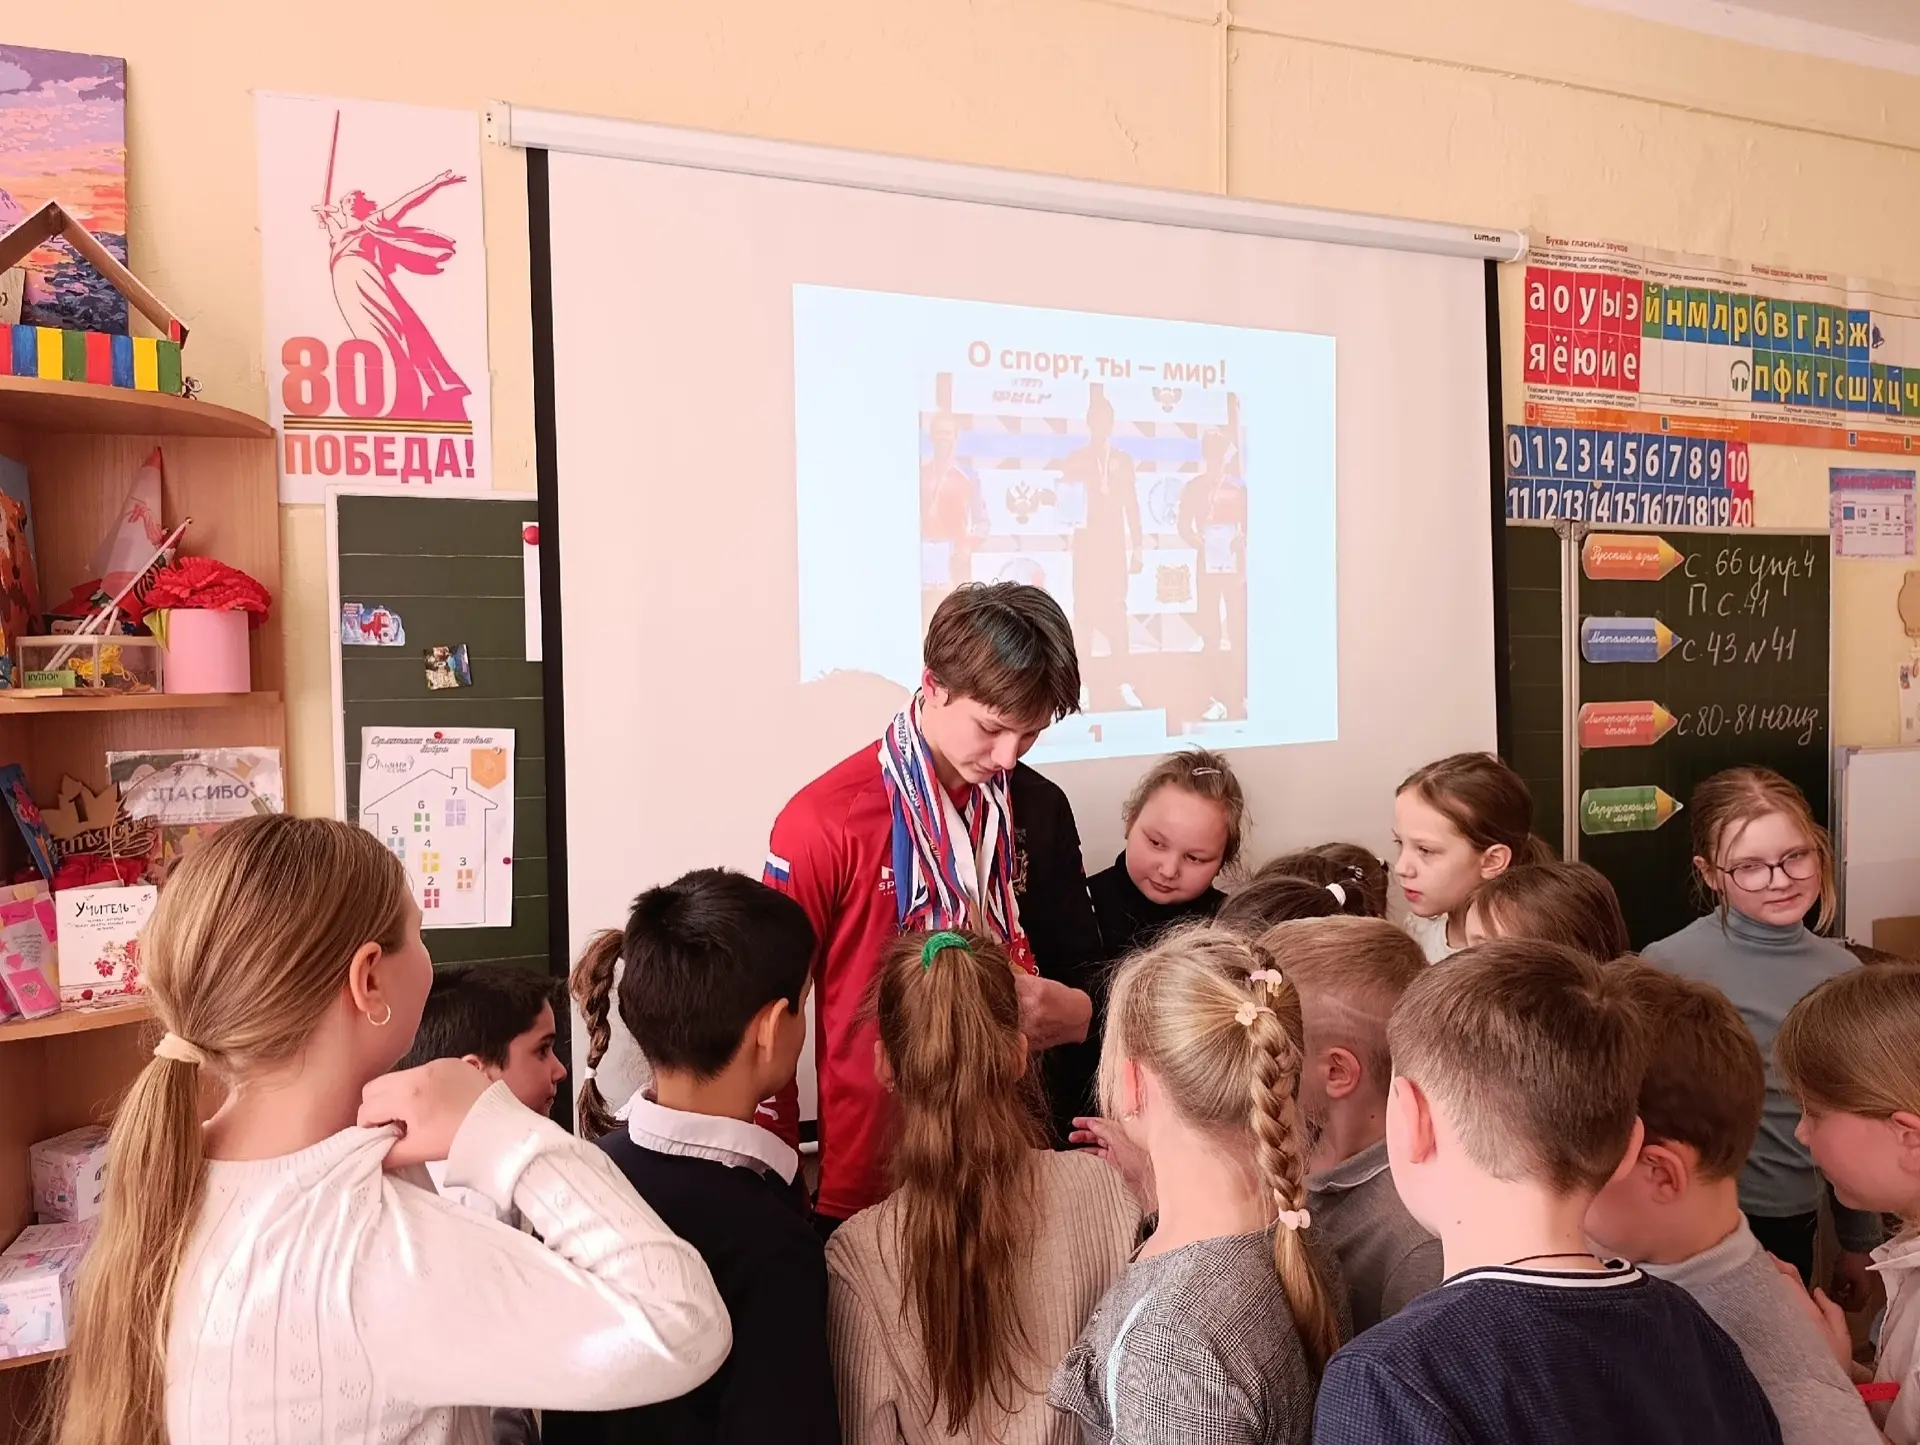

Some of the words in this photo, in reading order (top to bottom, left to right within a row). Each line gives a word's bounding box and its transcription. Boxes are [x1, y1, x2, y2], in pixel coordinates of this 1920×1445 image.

[1546, 236, 1568, 246] Буквы
[1606, 241, 1628, 253] звуков
[1529, 282, 1545, 310] а
[1553, 285, 1570, 314] о
[1578, 286, 1596, 325] у
[1602, 289, 1620, 318] ы
[1625, 292, 1638, 321] э
[1645, 286, 1660, 324] й
[1666, 300, 1682, 326] н
[1688, 301, 1708, 328] м
[1712, 303, 1728, 331] л
[1734, 306, 1748, 342] р
[1754, 301, 1768, 336] б
[1774, 312, 1789, 338] в
[1797, 314, 1808, 340] г
[1815, 316, 1831, 350] д
[1835, 320, 1845, 345] з
[1848, 322, 1868, 348] ж
[968, 340, 991, 368] О
[1000, 349, 1090, 380] спорт,
[1095, 356, 1131, 378] ты
[1163, 359, 1226, 389] мир!
[1528, 343, 1546, 371] я
[1553, 334, 1568, 374] ё
[1574, 347, 1596, 376] ю
[1602, 350, 1616, 378] и
[1623, 352, 1637, 380] е
[1754, 364, 1768, 392] п
[1774, 358, 1792, 402] ф
[1796, 368, 1809, 395] к
[1816, 372, 1828, 397] т
[1834, 374, 1844, 400] с
[1848, 376, 1868, 402] ш
[1872, 378, 1884, 404] х
[1888, 380, 1900, 412] ц
[1906, 382, 1918, 408] ч
[282, 336, 385, 418] 80
[284, 434, 474, 484] ПОБЕДА!
[1508, 434, 1523, 469] 0
[1532, 436, 1544, 469] 1
[1555, 436, 1568, 471] 2
[1578, 438, 1591, 473] 3
[1600, 440, 1614, 474] 4
[1623, 442, 1637, 475] 5
[1645, 443, 1660, 477] 6
[1668, 444, 1682, 478] 7
[1688, 446, 1702, 480] 8
[1710, 448, 1722, 481] 9
[1728, 450, 1748, 482] 10
[1508, 487, 1530, 520] 11
[1536, 488, 1558, 520] 12
[1563, 490, 1584, 520] 13
[1589, 491, 1610, 522] 14
[1614, 492, 1636, 524] 15
[1640, 492, 1662, 524] 16
[1665, 494, 1686, 525] 17
[1686, 495, 1709, 526] 18
[1711, 496, 1730, 527] 19
[1732, 498, 1750, 527] 20
[1590, 545, 1633, 566] Русский
[1716, 548, 1742, 577] 66
[1749, 553, 1800, 600] упр
[1804, 549, 1815, 578] 4
[1588, 630, 1657, 644] Математика
[147, 784, 249, 803] СПАСИБО
[450, 786, 458, 796] 7
[68, 795, 89, 823] 1
[418, 800, 425, 810] 6
[391, 826, 399, 834] 5
[1613, 813, 1637, 827] мир
[424, 839, 431, 848] 4
[460, 857, 467, 866] 3
[428, 876, 434, 886] 2
